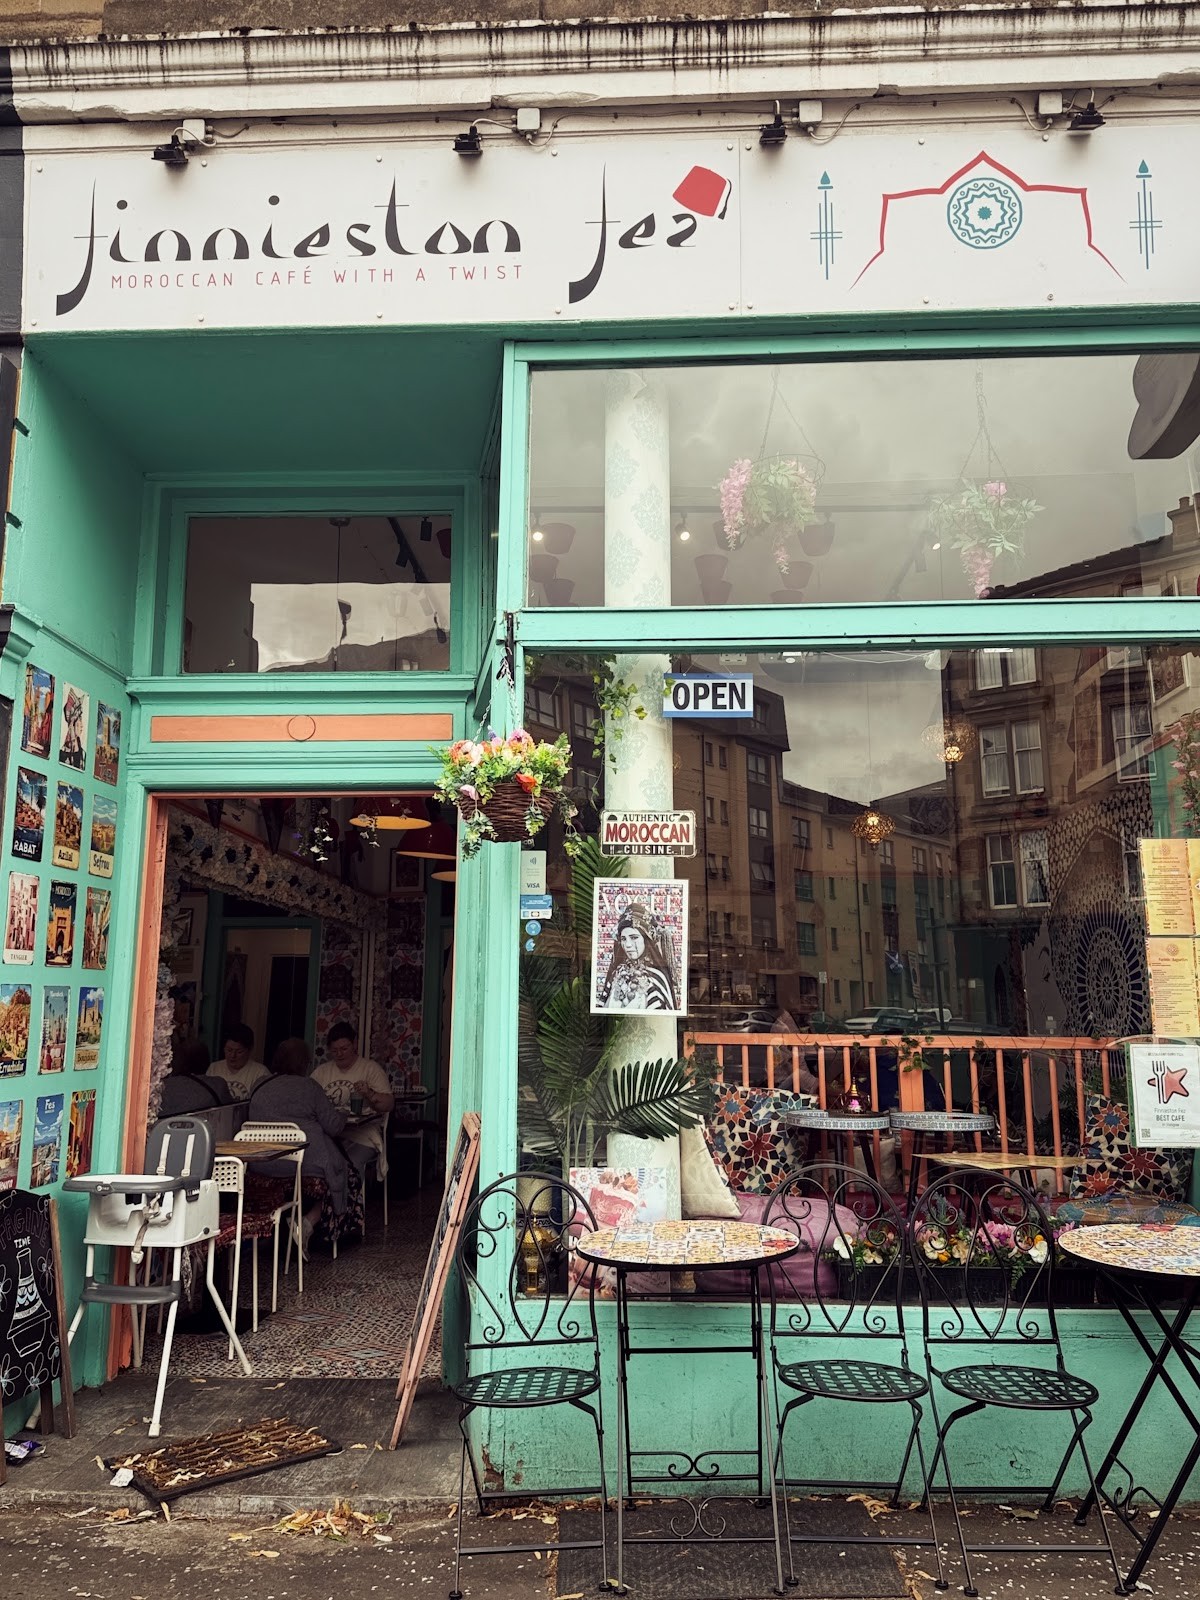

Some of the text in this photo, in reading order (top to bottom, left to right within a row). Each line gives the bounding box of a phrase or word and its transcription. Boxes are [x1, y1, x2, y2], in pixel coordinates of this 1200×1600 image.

[110, 264, 523, 289] MOROCCAN CAFÉ WITH A TWIST
[672, 682, 746, 710] OPEN
[621, 813, 675, 823] AUTHENTIC
[605, 822, 690, 843] MOROCCAN
[14, 841, 36, 854] RABAT
[624, 845, 672, 855] CUISINE
[44, 1099, 56, 1110] Fes
[13, 1235, 32, 1249] TIME
